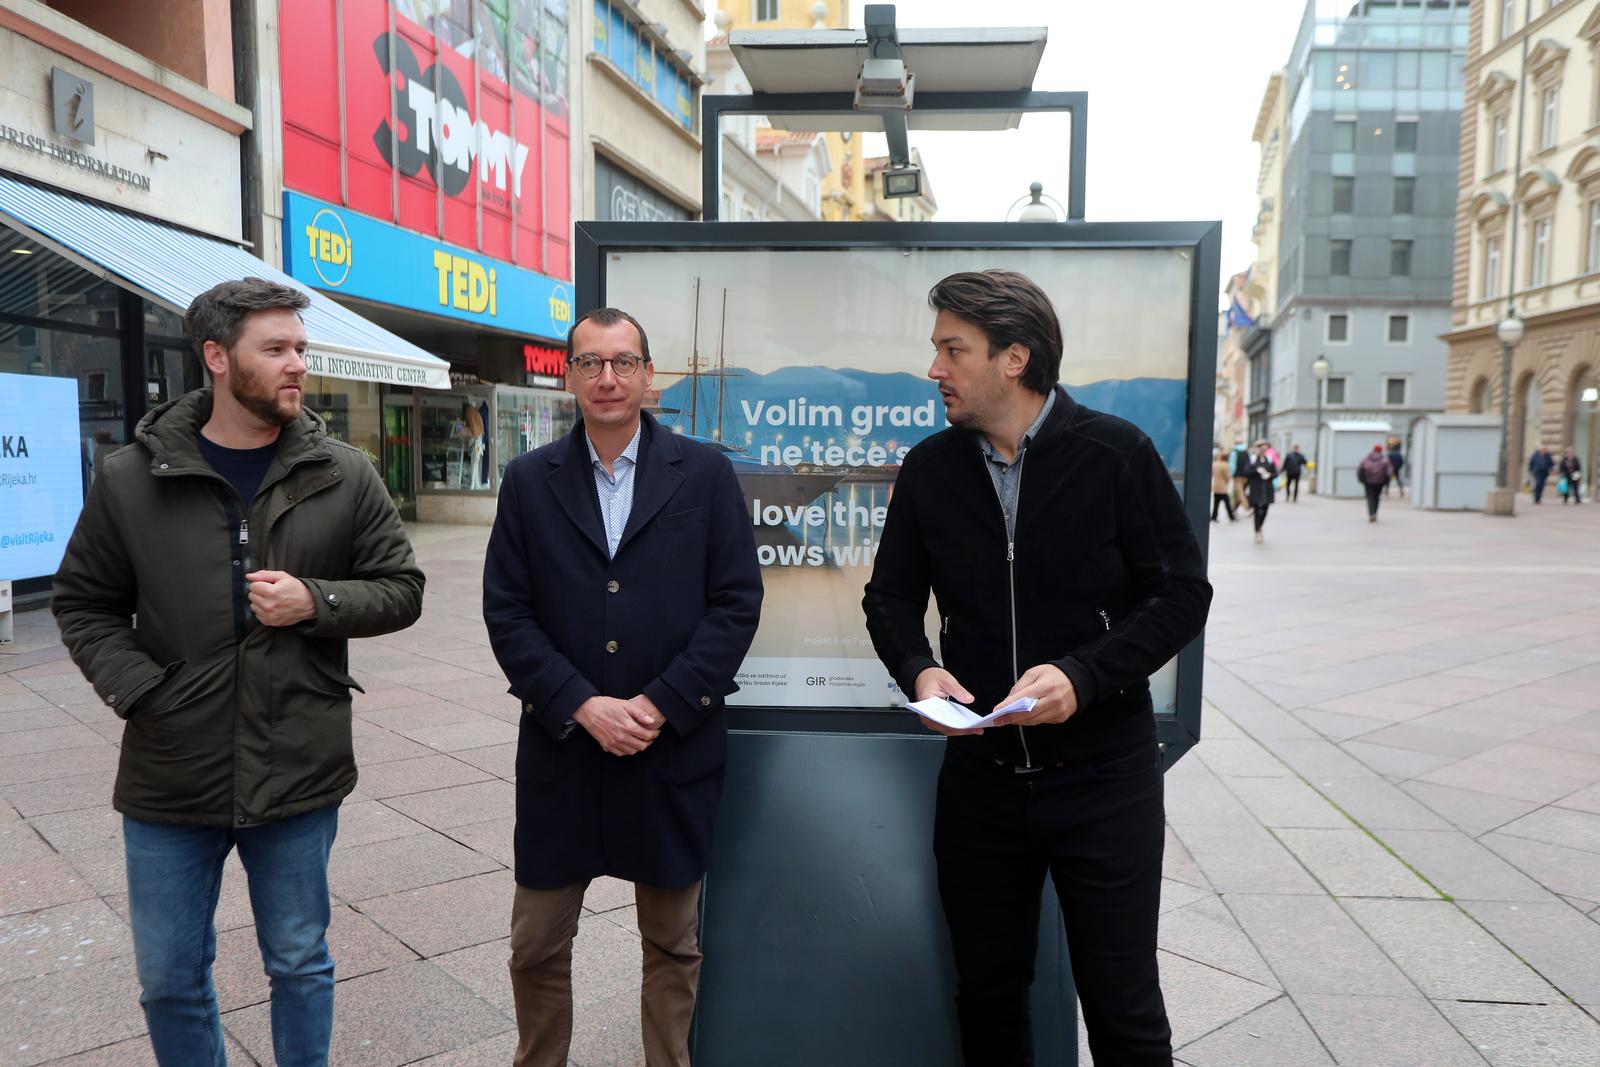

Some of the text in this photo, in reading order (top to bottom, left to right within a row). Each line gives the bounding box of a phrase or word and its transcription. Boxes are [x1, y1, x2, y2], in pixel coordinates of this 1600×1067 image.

[408, 78, 529, 198] TOMMY
[49, 141, 151, 193] INFORMATION
[306, 225, 352, 268] TEDi
[434, 249, 496, 317] TEDi
[549, 297, 571, 323] TEDi
[328, 357, 393, 380] INFORMATIVNI
[397, 367, 427, 384] CENTAR
[524, 343, 567, 376] TOMMY
[740, 397, 842, 426] Volim
[851, 400, 935, 436] grad
[0, 435, 29, 458] KA
[760, 444, 802, 466] ne
[753, 499, 888, 527] love the
[1, 531, 54, 549] @visitRijeka
[806, 676, 826, 686] GIR
